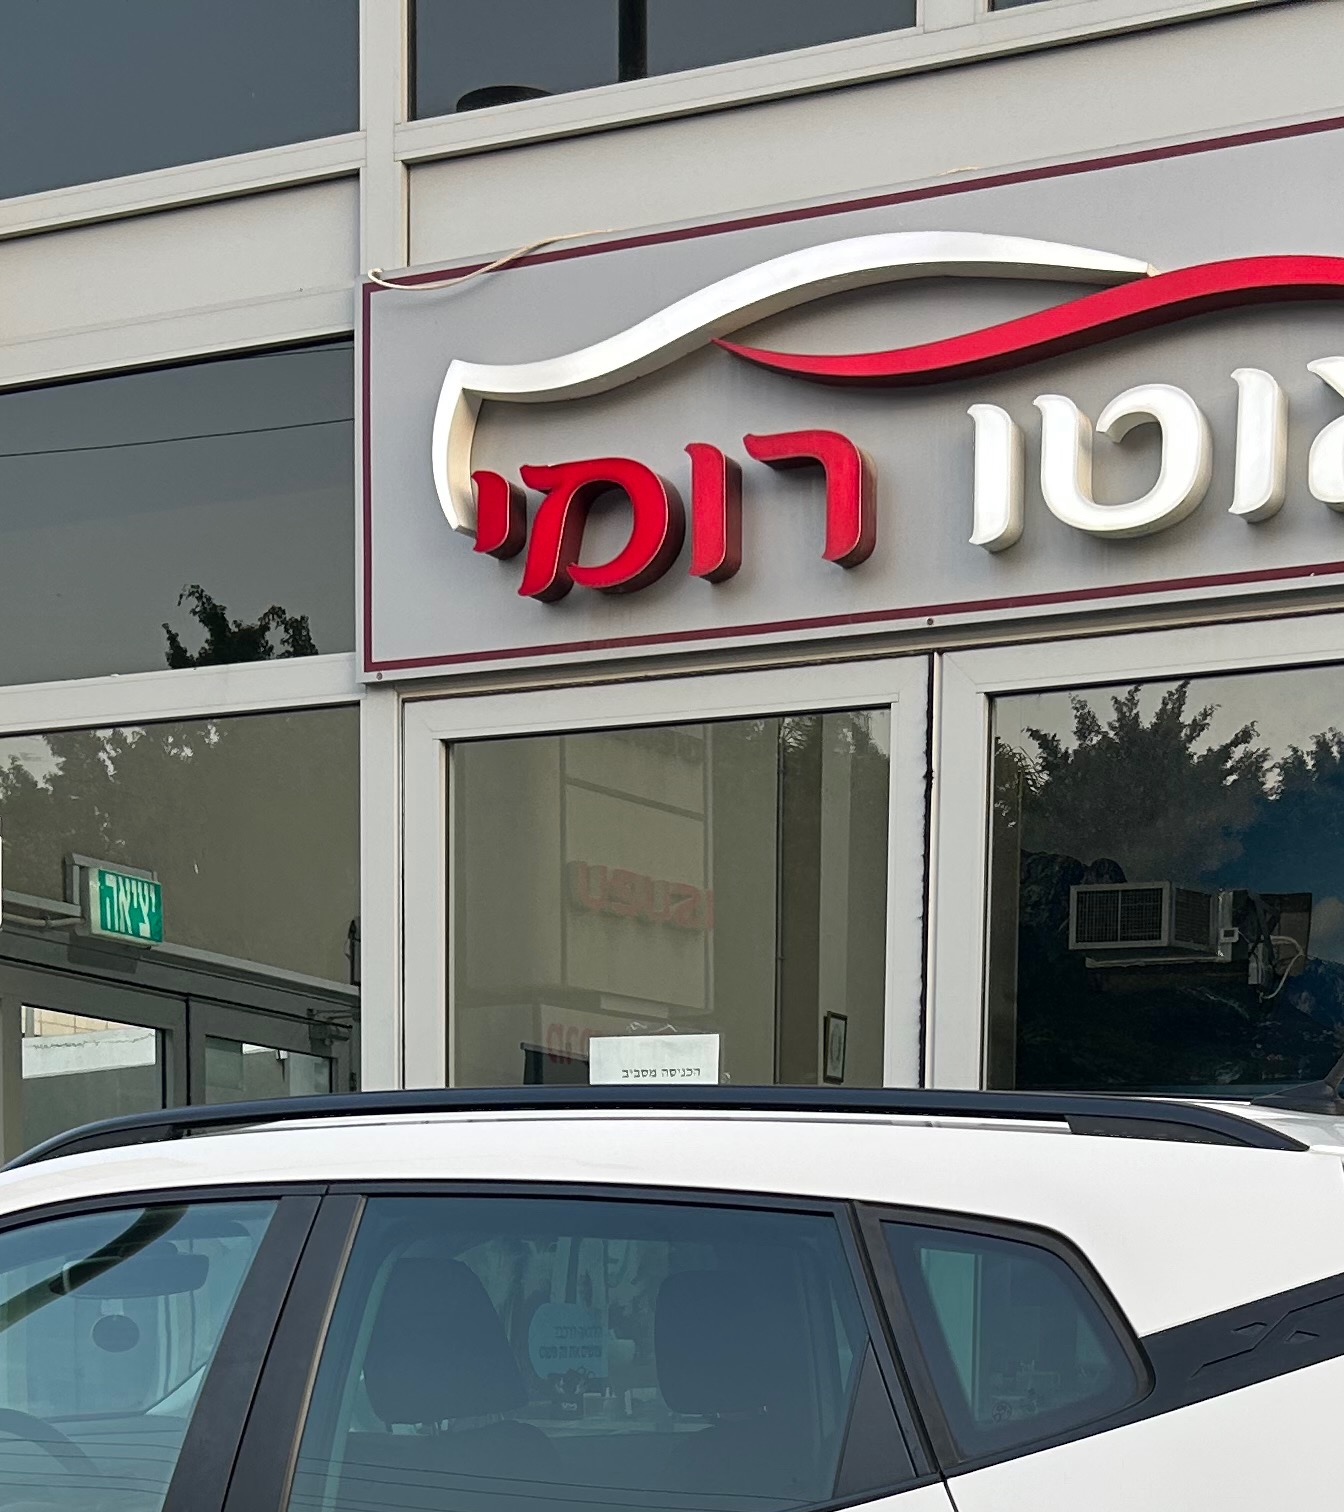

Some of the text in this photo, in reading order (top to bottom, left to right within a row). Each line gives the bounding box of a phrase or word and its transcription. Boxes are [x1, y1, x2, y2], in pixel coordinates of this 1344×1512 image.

[470, 428, 877, 601] רומי
[105, 873, 156, 938] יציאה
[621, 1067, 701, 1079] הכניסה מסביב
